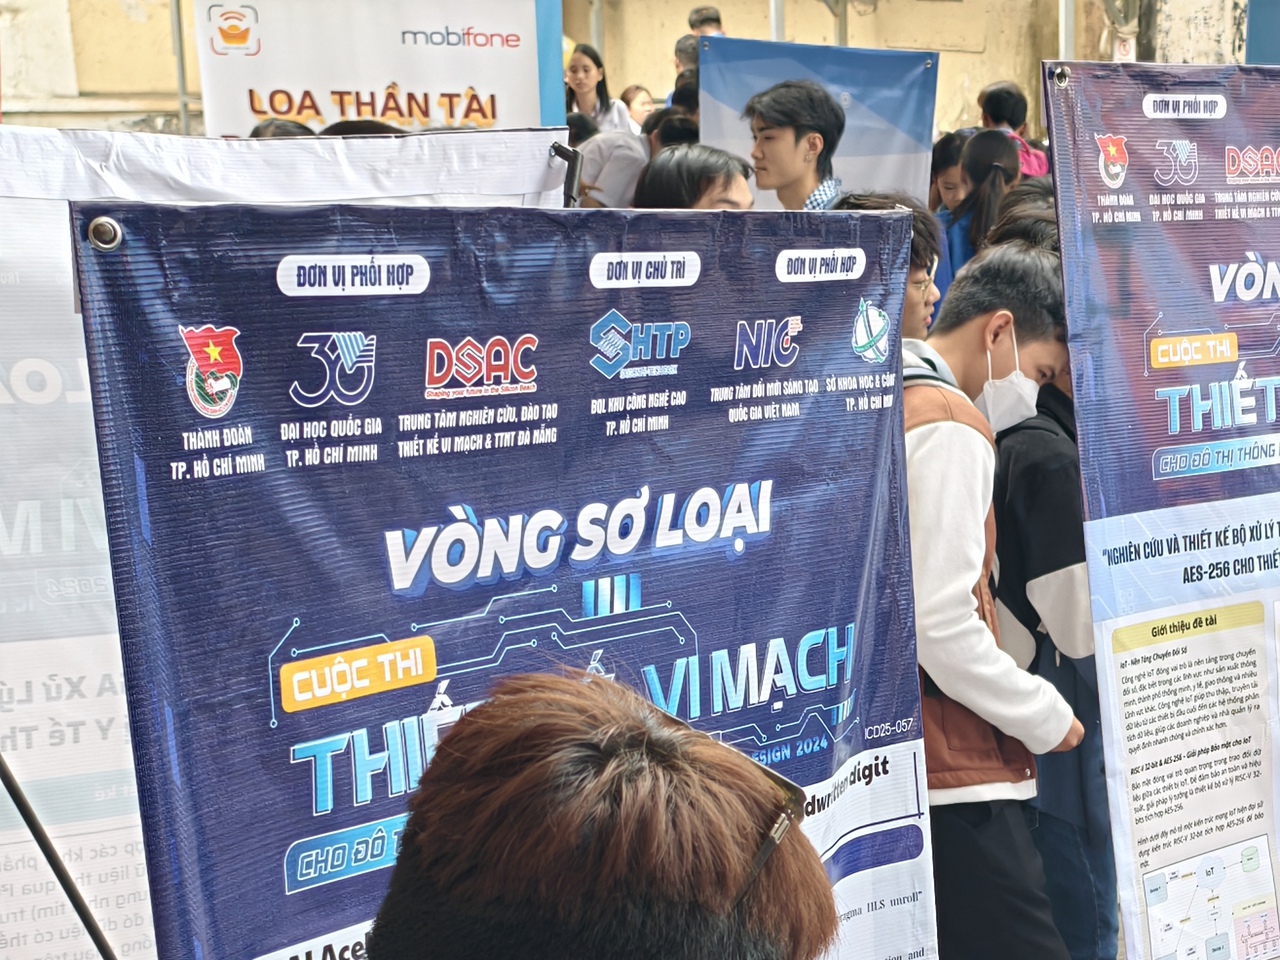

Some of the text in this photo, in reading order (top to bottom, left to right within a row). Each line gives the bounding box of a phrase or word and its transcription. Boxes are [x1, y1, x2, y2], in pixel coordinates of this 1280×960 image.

[401, 26, 520, 48] mobifone
[248, 88, 322, 117] LOA
[296, 256, 414, 292] ĐƠN VỊ PHỐI HỢP
[606, 255, 686, 284] ĐƠN VỊ CHỦ TRÌ
[733, 316, 803, 371] NIC
[1157, 338, 1231, 366] CUỘC THI
[425, 334, 539, 387] DSAC
[398, 413, 431, 432] TRUNG
[434, 409, 456, 429] TÂM
[459, 405, 495, 427] NGHIÊN
[521, 402, 540, 421] ĐÀO
[542, 403, 558, 422] TẠO
[182, 425, 253, 451] THÀNH ĐOÀN
[1159, 449, 1190, 472] CHO
[1191, 444, 1212, 469] ĐÔ
[1214, 445, 1234, 470] THỊ
[1237, 437, 1275, 462] THÔNG
[384, 479, 774, 591] VÒNG SƠ LOẠI
[1143, 536, 1164, 559] CỨU
[1166, 533, 1180, 555] VÀ
[1182, 527, 1213, 552] THIẾT
[1215, 524, 1231, 547] KẾ
[1232, 523, 1247, 547] BỘ
[1249, 520, 1263, 542] XỬ
[1265, 518, 1276, 540] LÝ
[1182, 562, 1231, 585] AES-256
[1233, 558, 1255, 577] CHO
[1151, 614, 1217, 638] Giới thiệu đề tài
[291, 648, 424, 702] CUỘC THI
[640, 658, 700, 723] VI
[709, 622, 857, 716] MẠCH
[864, 718, 914, 740] ICD25-057
[751, 736, 829, 766] ESIGN 2024
[804, 755, 890, 817] dwritten digit
[297, 843, 347, 881] CHO
[352, 826, 387, 866] ĐÔ
[1205, 866, 1215, 877] IoT
[908, 947, 925, 960] and
